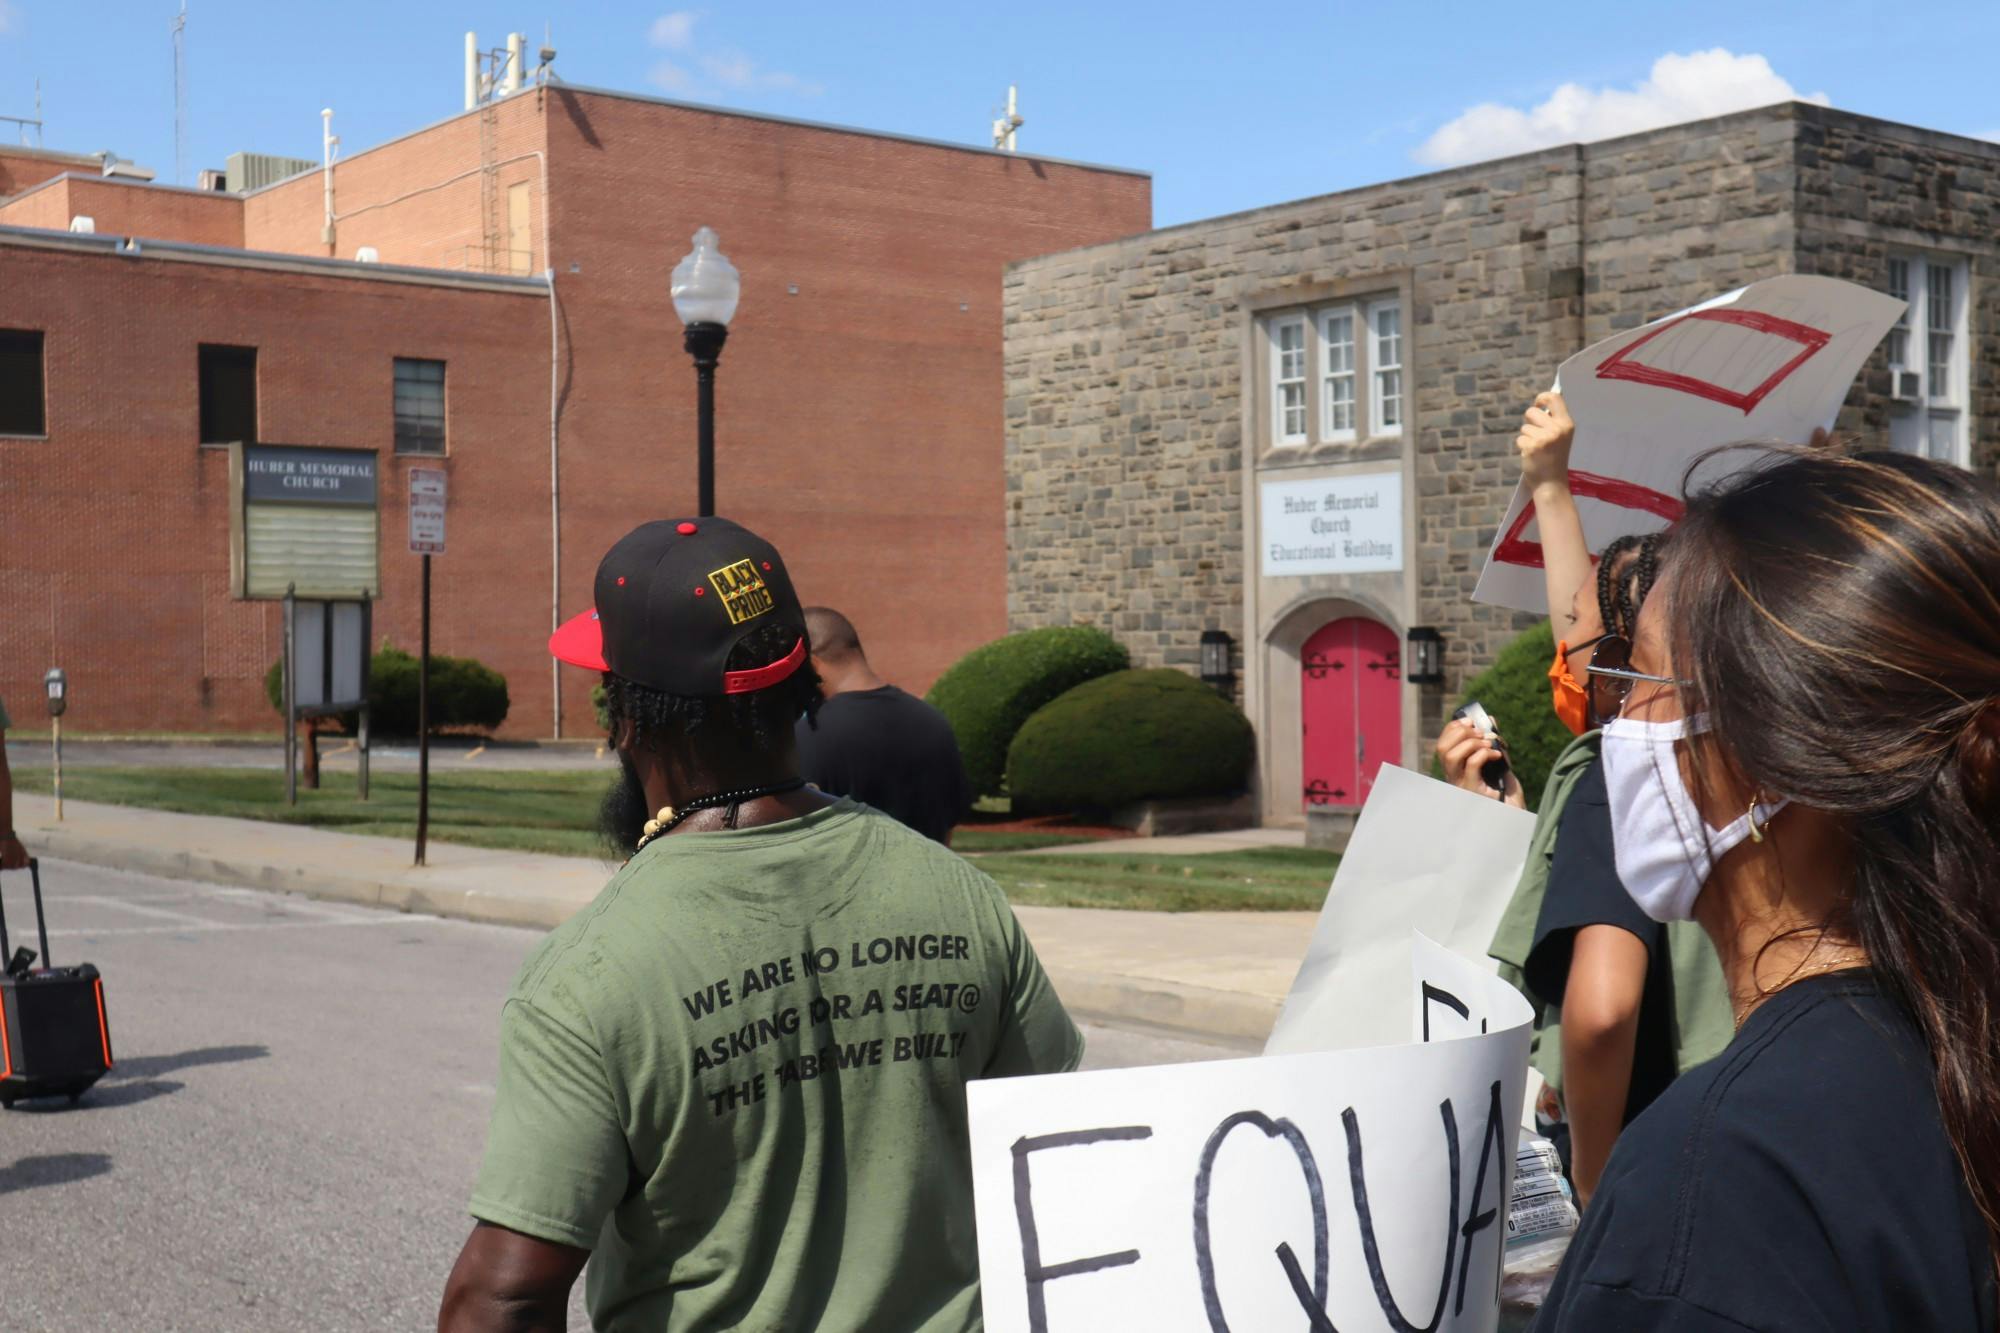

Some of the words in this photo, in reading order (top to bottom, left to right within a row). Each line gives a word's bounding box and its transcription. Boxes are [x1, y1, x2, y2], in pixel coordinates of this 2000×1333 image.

[248, 460, 295, 473] HUBER
[300, 462, 373, 477] MEMORIAL
[283, 475, 339, 489] CHURCH
[1284, 496, 1317, 514] Huber
[1324, 491, 1379, 512] Memorial
[1310, 516, 1351, 536] Church
[1270, 542, 1336, 561] Educational
[1344, 539, 1393, 560] Building
[711, 560, 764, 597] BLACK
[683, 979, 733, 1021] WE
[742, 957, 795, 999] ARE
[802, 947, 839, 978] NO
[851, 934, 970, 968] LONGER
[692, 1007, 800, 1079] ASKING
[861, 989, 884, 1017] A
[893, 984, 980, 1014] SEAT@
[709, 1073, 766, 1117] THE
[834, 1039, 883, 1070] WE
